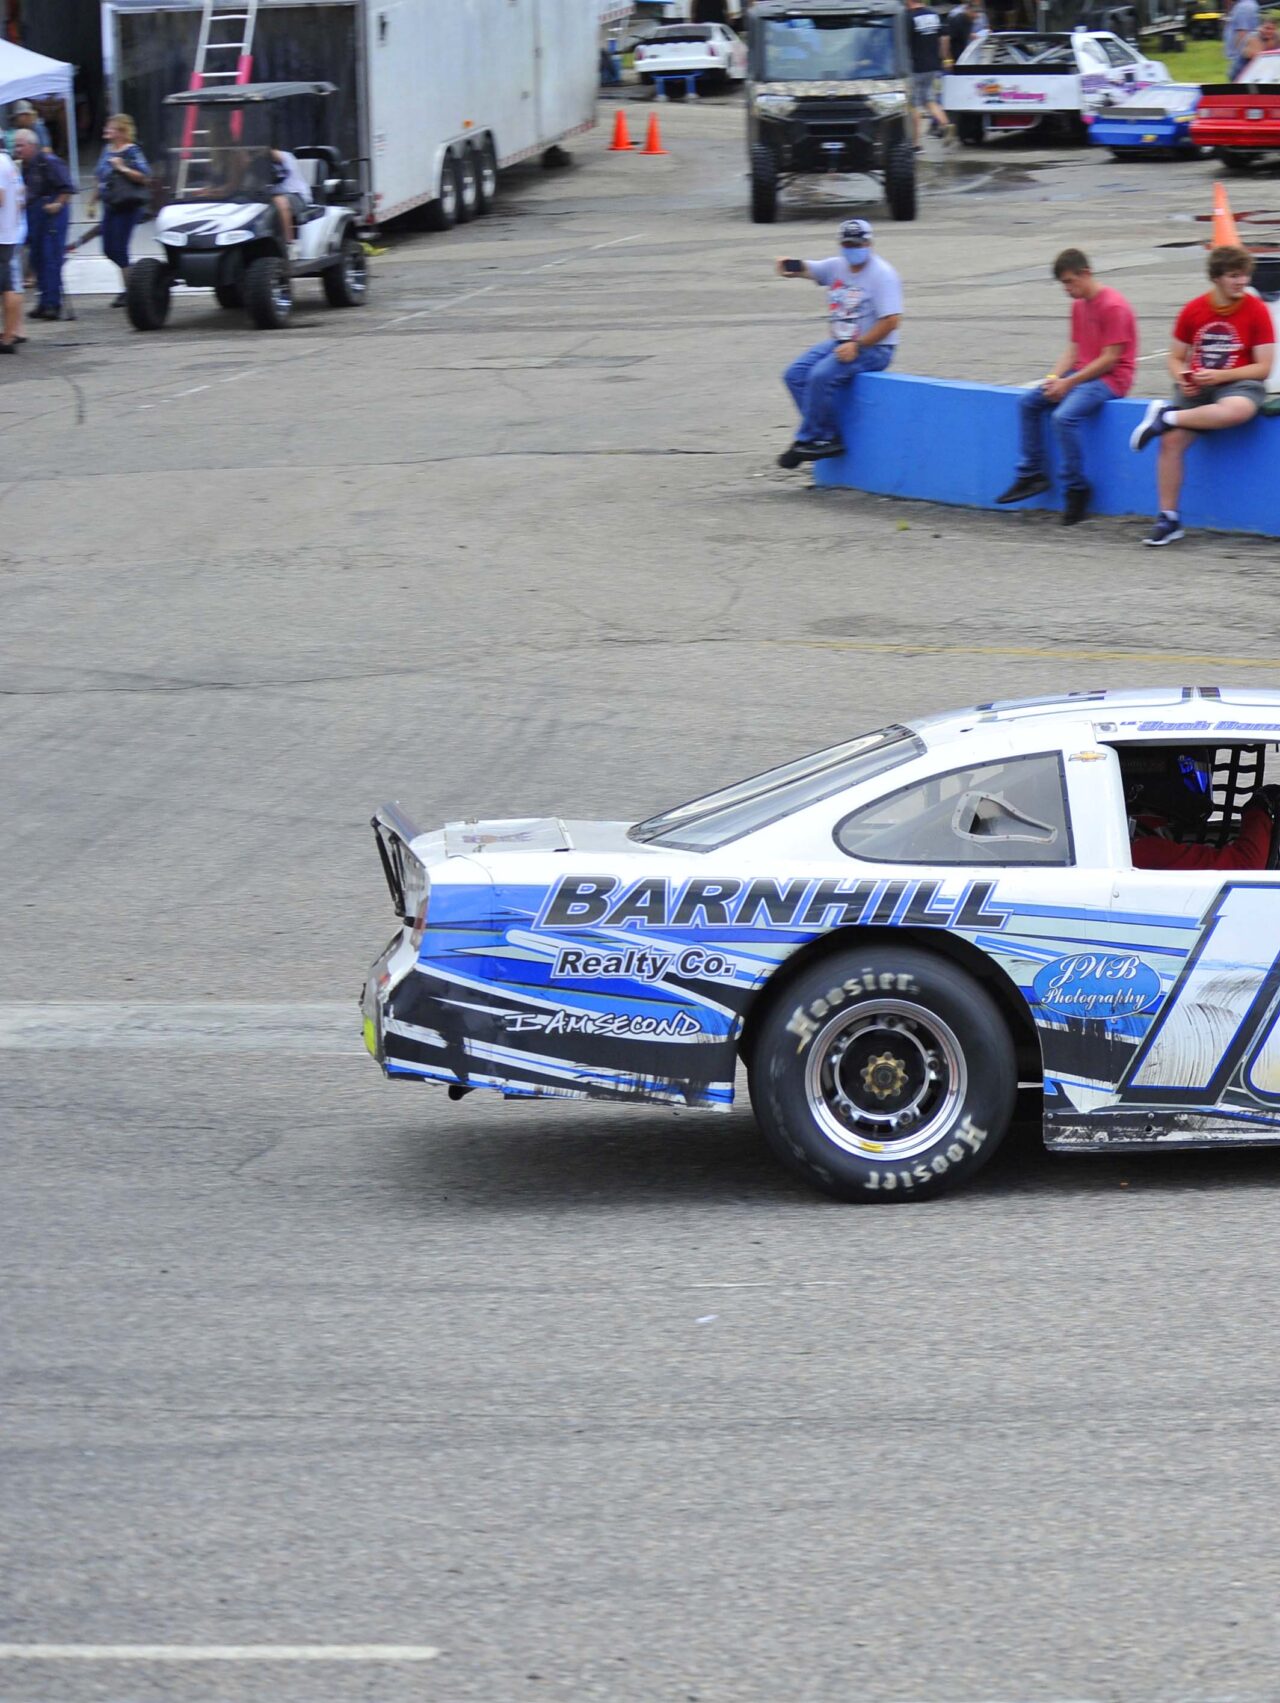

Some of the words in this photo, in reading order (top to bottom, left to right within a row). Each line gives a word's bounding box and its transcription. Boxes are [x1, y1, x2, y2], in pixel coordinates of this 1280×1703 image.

[533, 874, 1015, 930] BARNHILL
[552, 945, 676, 983] Realty
[674, 946, 737, 978] Co.
[1048, 955, 1141, 989] JWB
[786, 967, 915, 1054] Hoosier
[1042, 988, 1147, 1011] Photography
